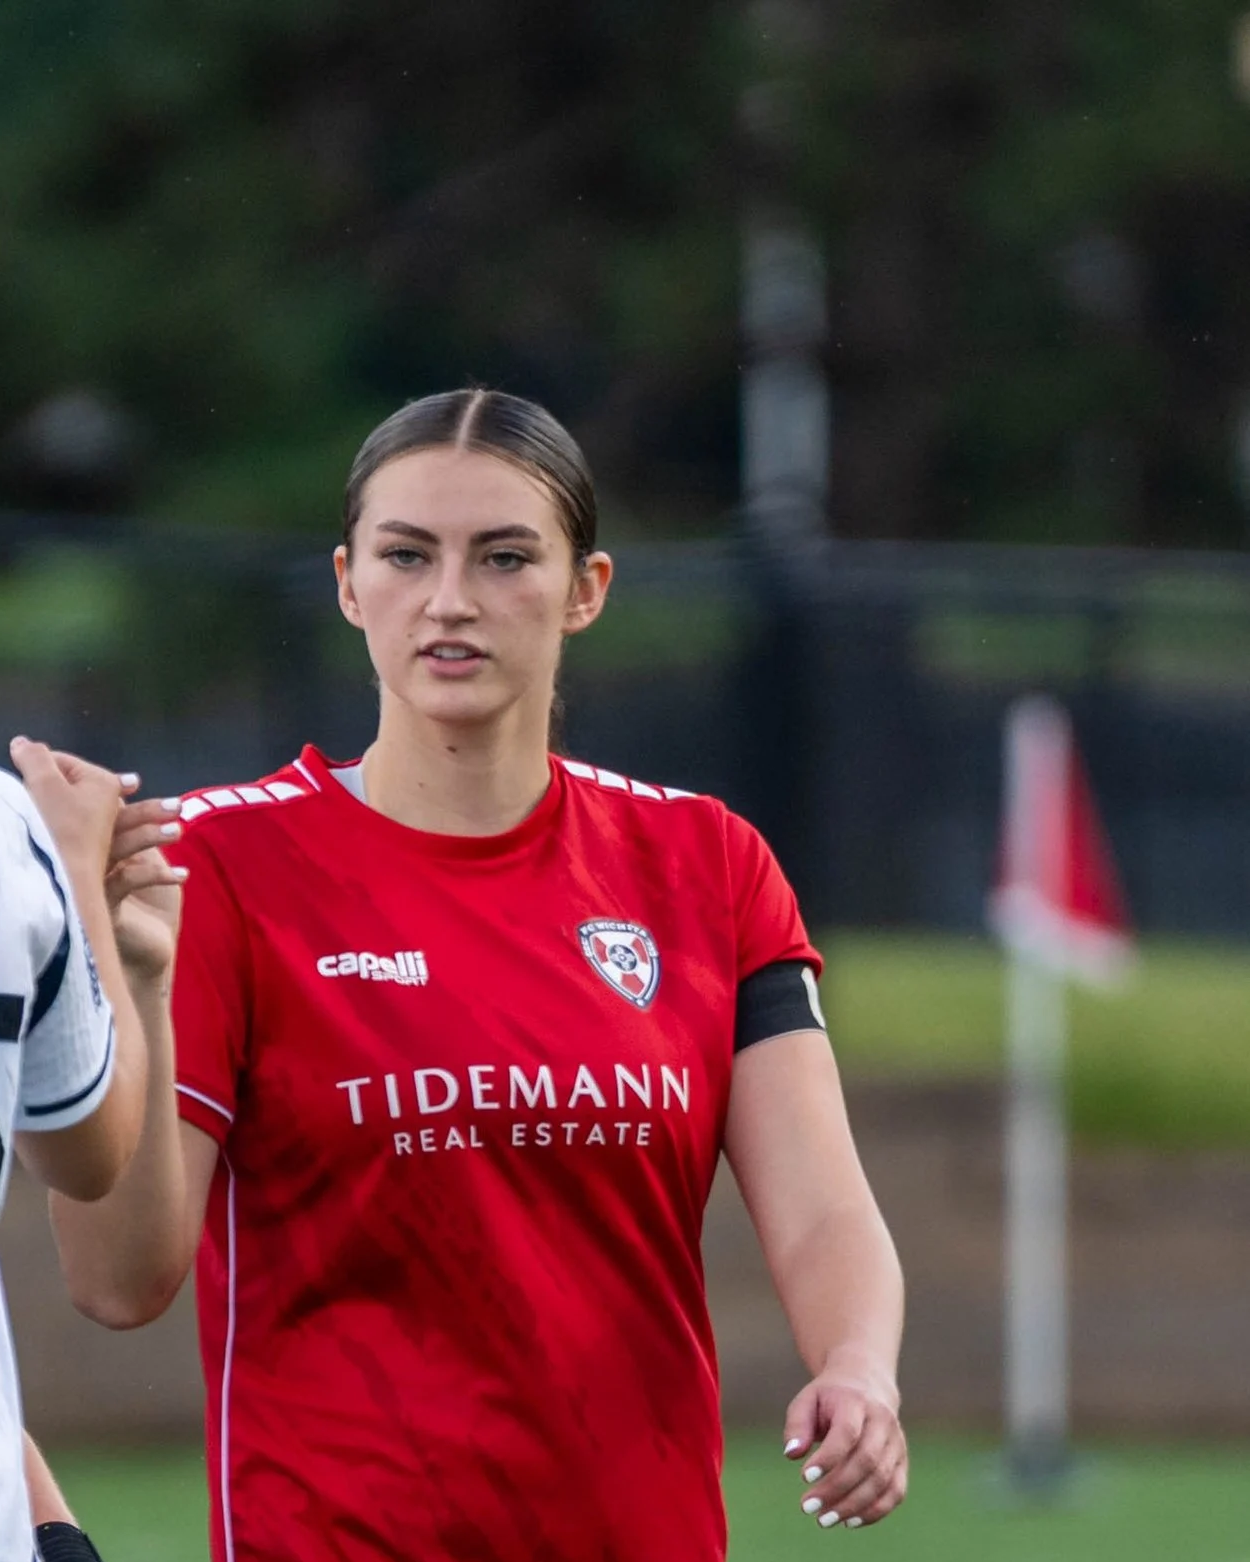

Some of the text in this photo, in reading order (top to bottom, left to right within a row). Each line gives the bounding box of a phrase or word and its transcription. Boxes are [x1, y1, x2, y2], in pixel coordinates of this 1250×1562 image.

[316, 951, 429, 980] capelli
[335, 1063, 690, 1125] TIDEMANN
[394, 1122, 652, 1156] REAL ESTATE
